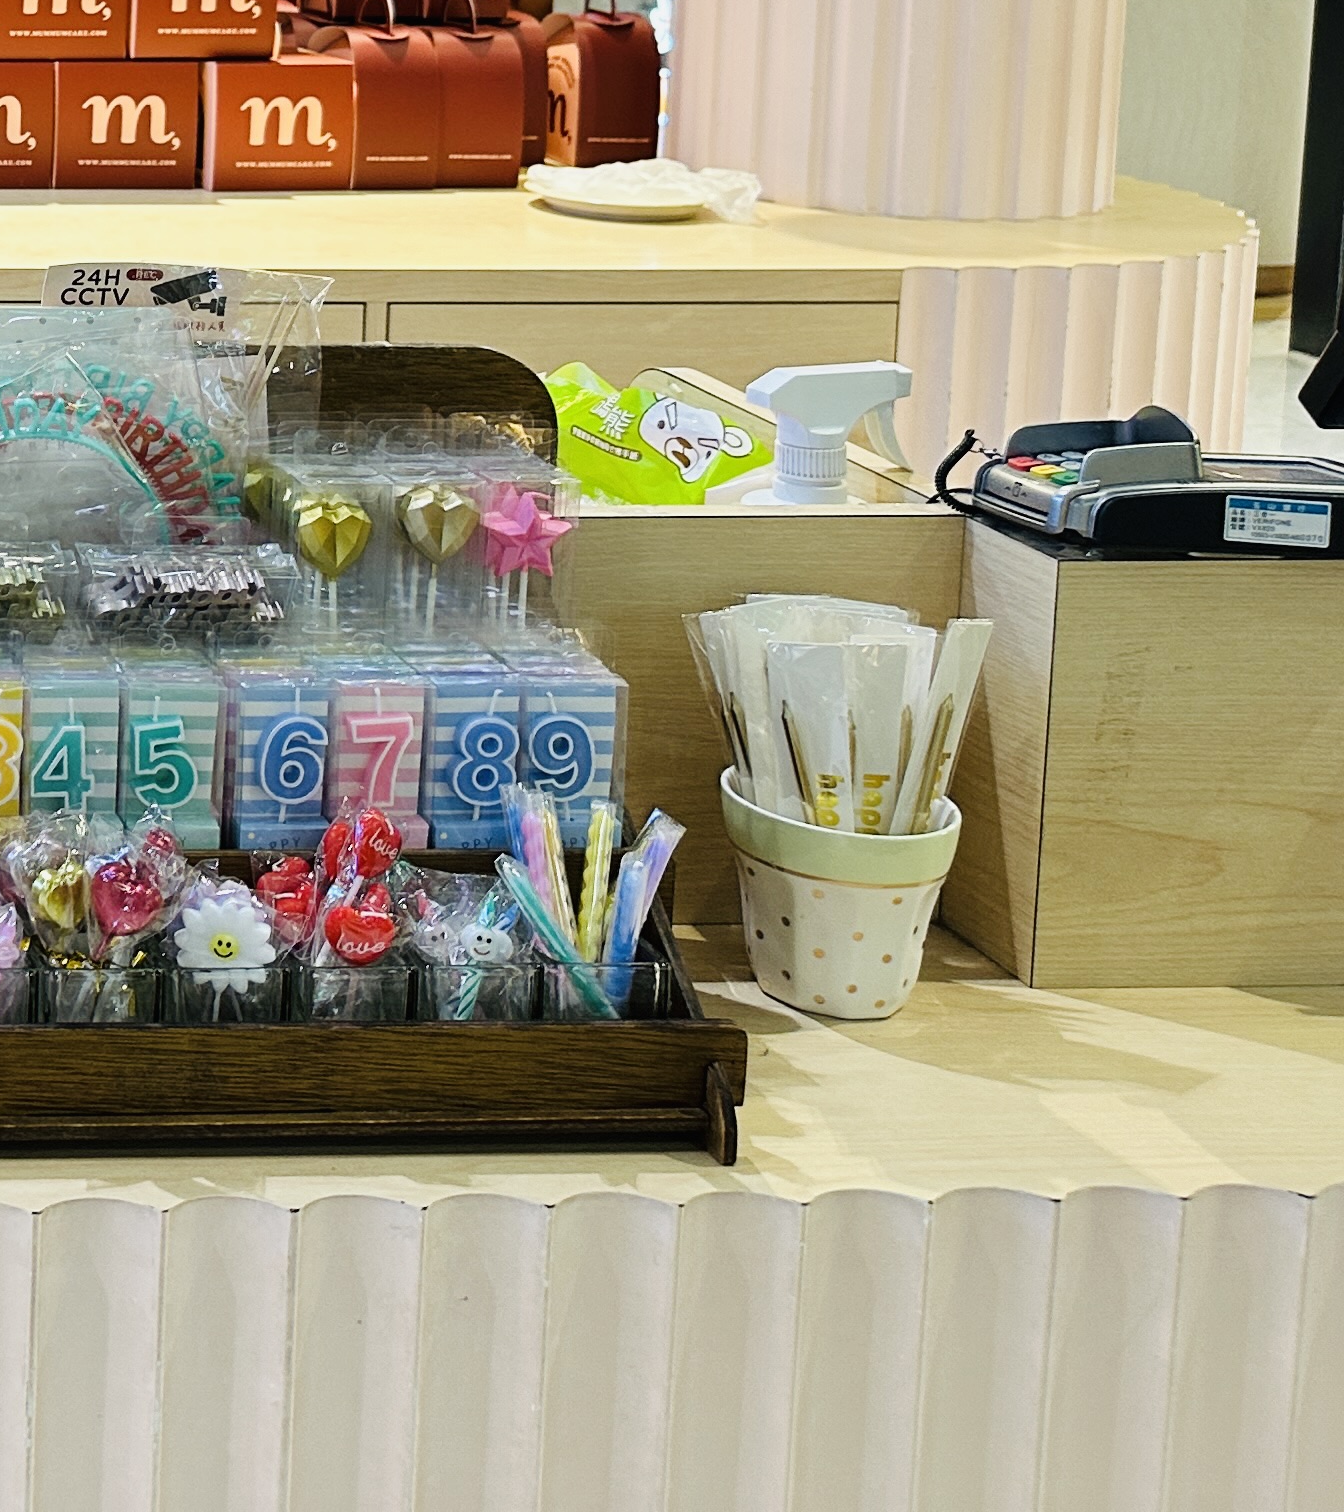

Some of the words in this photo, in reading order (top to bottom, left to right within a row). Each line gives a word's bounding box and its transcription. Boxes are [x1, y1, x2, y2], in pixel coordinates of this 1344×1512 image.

[81, 94, 182, 151] m,
[239, 95, 339, 153] m,
[60, 287, 130, 306] CCTV
[71, 268, 121, 286] 24H
[30, 718, 95, 813] 4
[130, 714, 200, 808] 5
[258, 713, 330, 807] 6
[344, 710, 416, 808] 7
[447, 714, 522, 808] 8
[528, 713, 596, 803] 9
[368, 827, 400, 861] love
[335, 934, 388, 956] love
